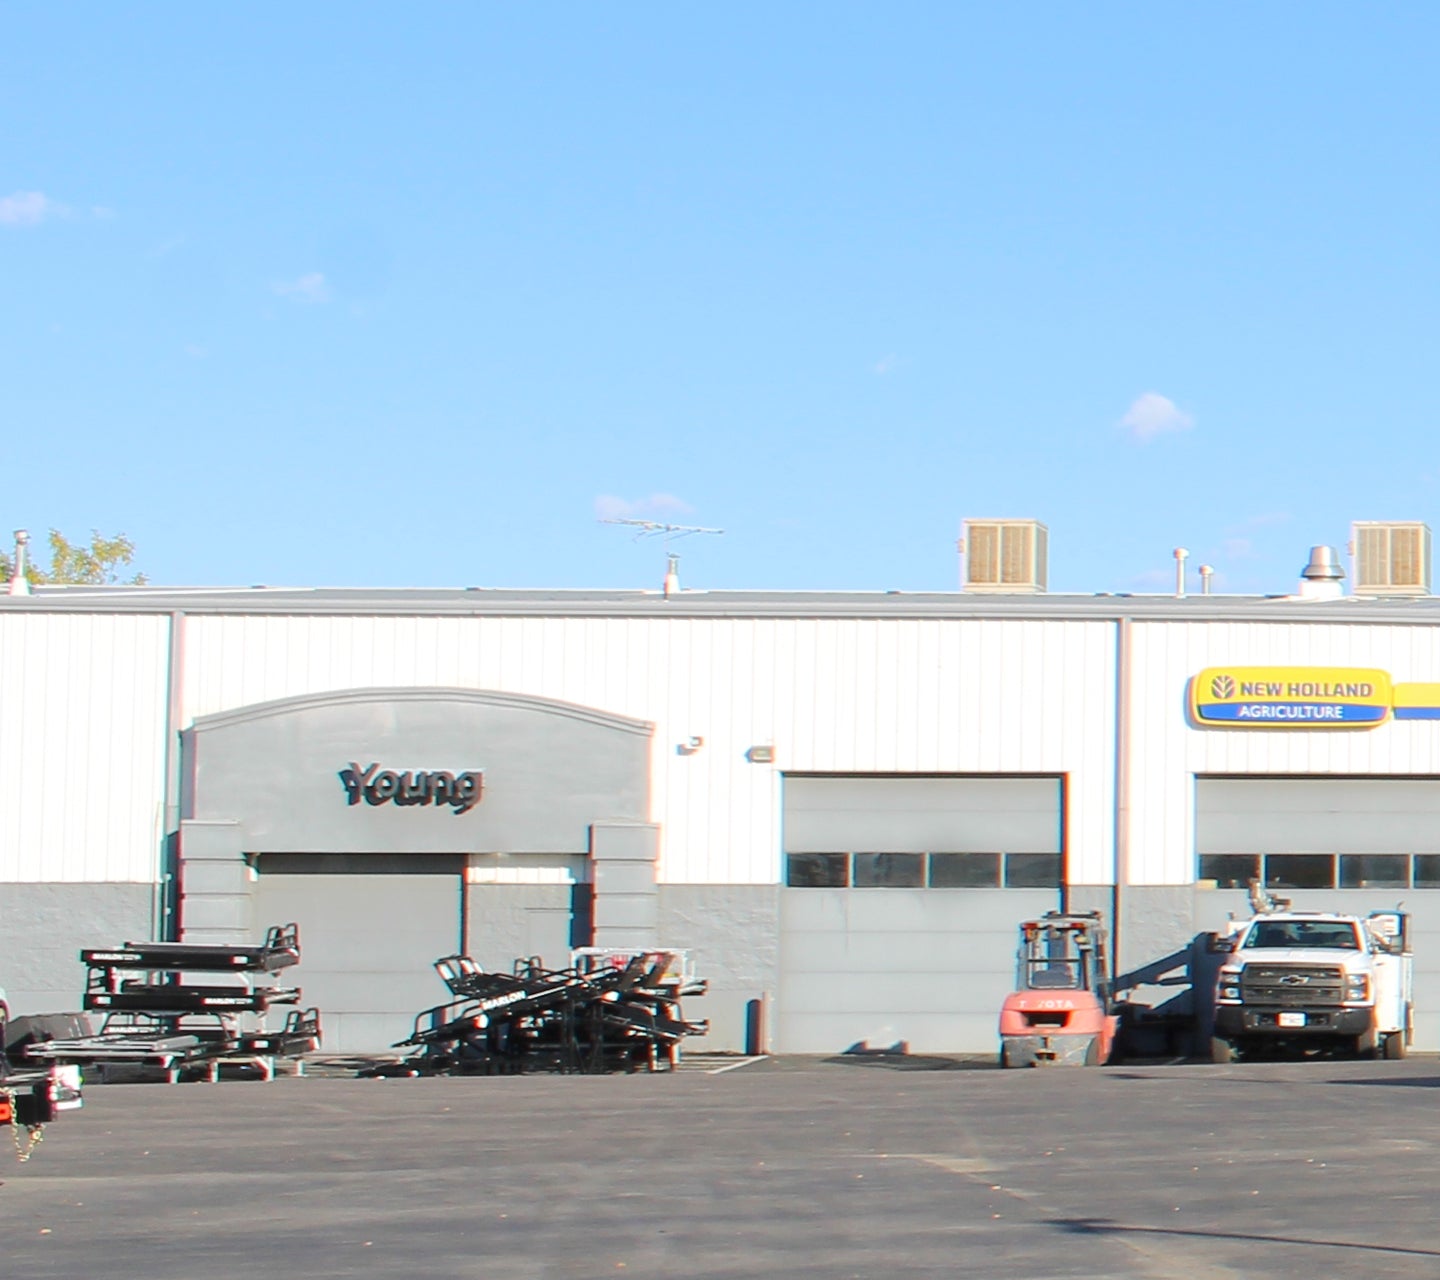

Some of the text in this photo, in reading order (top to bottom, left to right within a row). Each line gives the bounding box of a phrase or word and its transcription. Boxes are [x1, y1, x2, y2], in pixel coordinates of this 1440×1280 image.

[1240, 681, 1373, 698] NEW HOLLAND
[1239, 705, 1344, 719] AGRICULTURE
[343, 762, 484, 813] Young
[480, 990, 527, 1011] MARLON
[1019, 1000, 1075, 1009] TOTA
